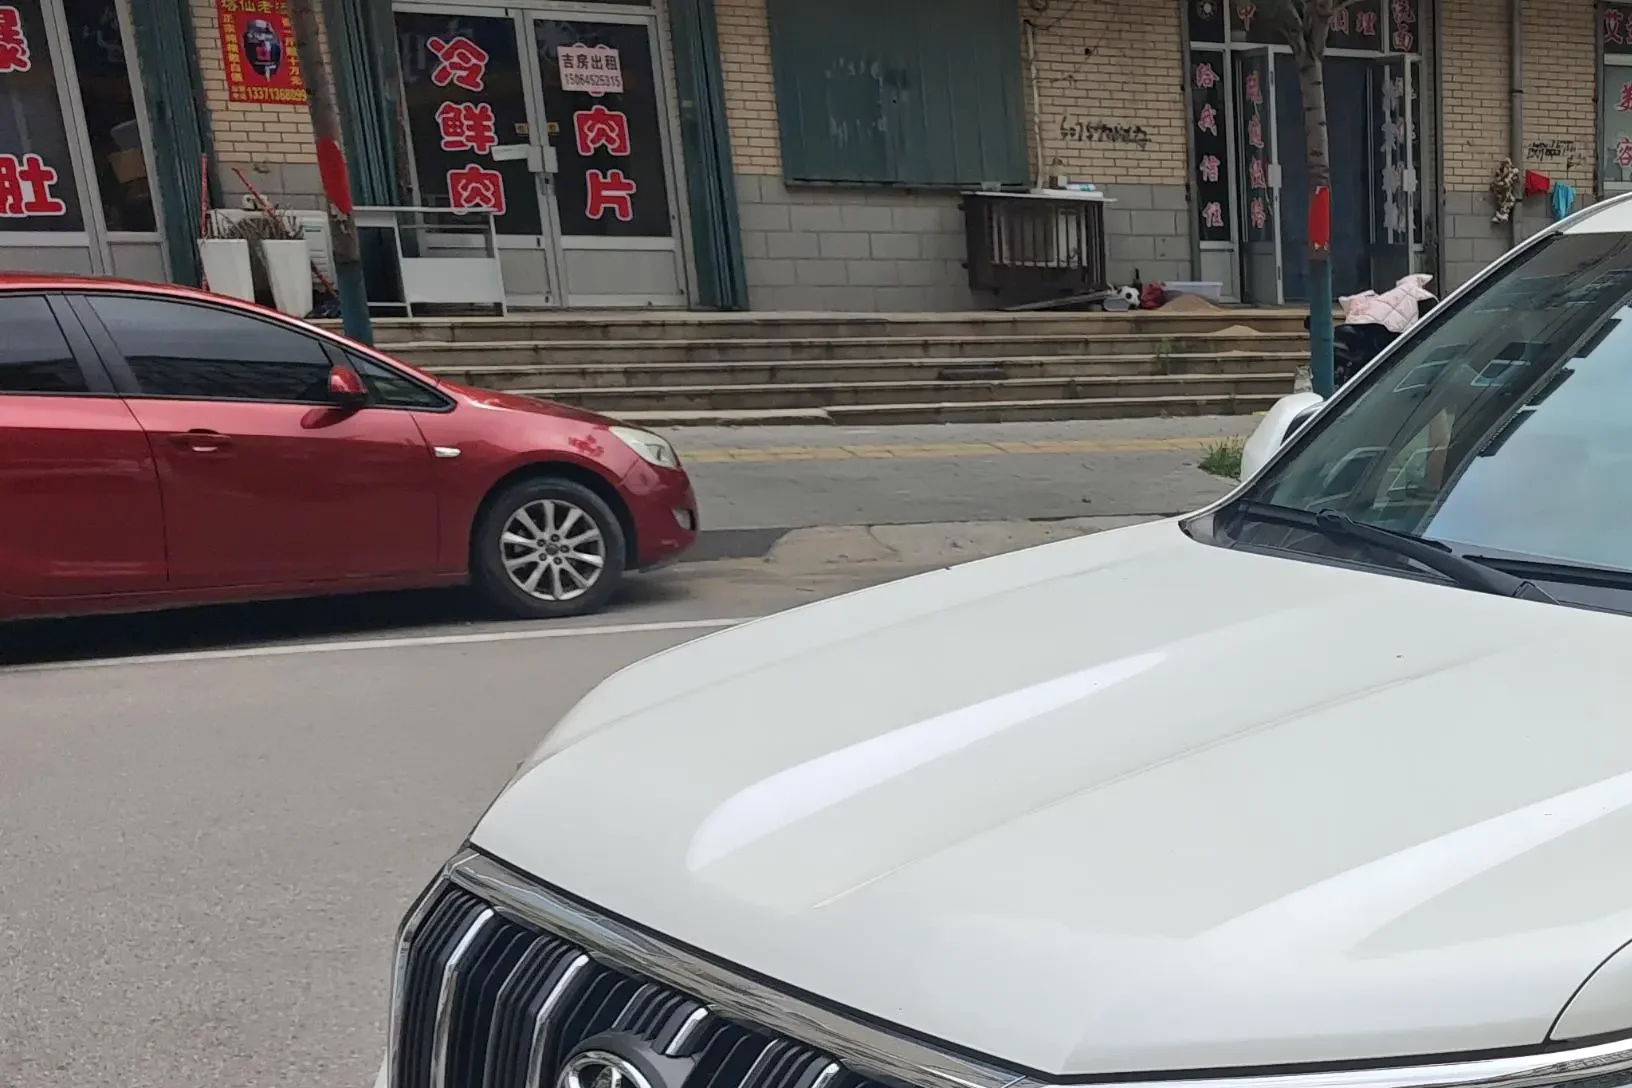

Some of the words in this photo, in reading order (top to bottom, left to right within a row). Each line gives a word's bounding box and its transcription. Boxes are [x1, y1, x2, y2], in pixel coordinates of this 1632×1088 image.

[561, 53, 618, 71] 吉房出租
[427, 36, 506, 215] 冷鲜肉
